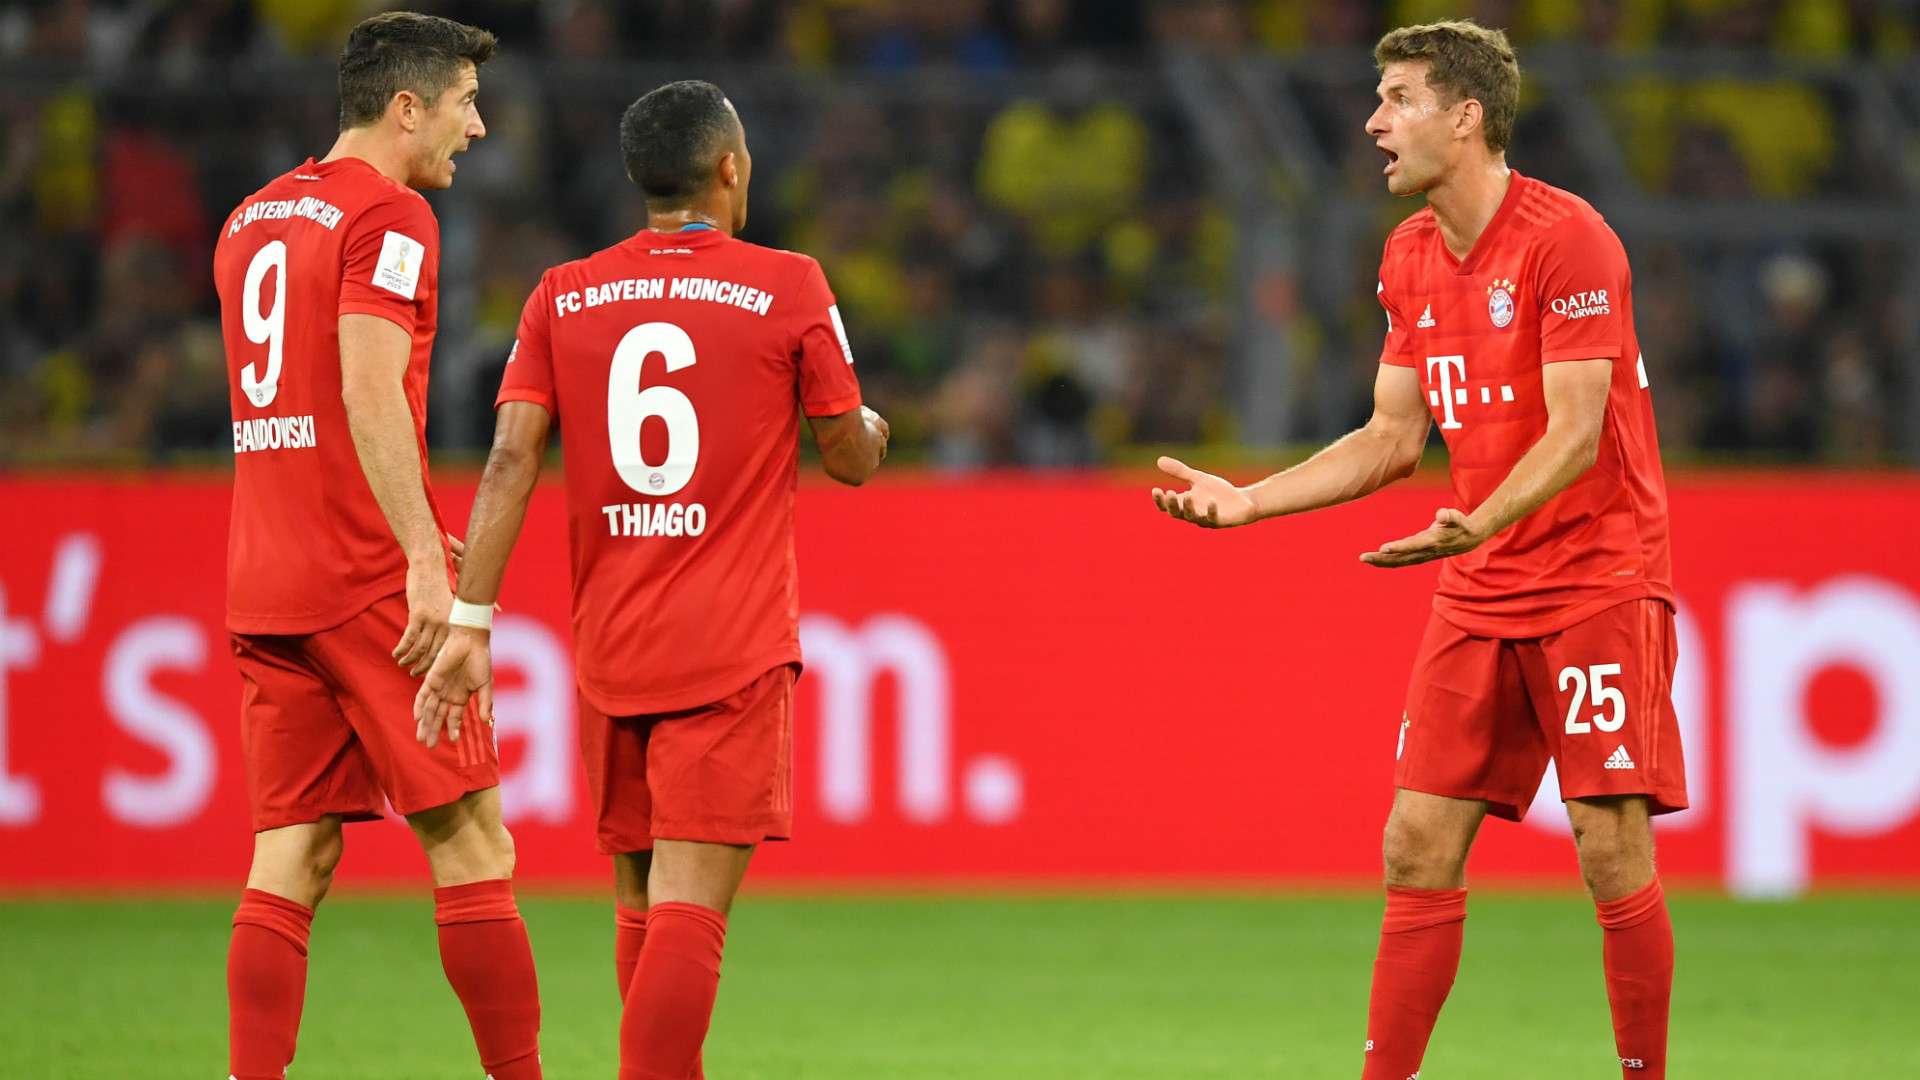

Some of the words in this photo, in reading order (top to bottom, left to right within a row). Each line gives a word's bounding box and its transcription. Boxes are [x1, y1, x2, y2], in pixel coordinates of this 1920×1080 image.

[555, 291, 582, 317] FC
[585, 278, 665, 308] BAYERN
[669, 277, 774, 316] MÜNCHEN
[1551, 289, 1609, 315] QATAR
[1567, 304, 1610, 320] AIRWAYS
[240, 239, 287, 408] 9
[607, 321, 700, 496] 6
[602, 502, 707, 537] THIAGO
[1558, 663, 1627, 735] 25
[1603, 759, 1636, 769] adidas
